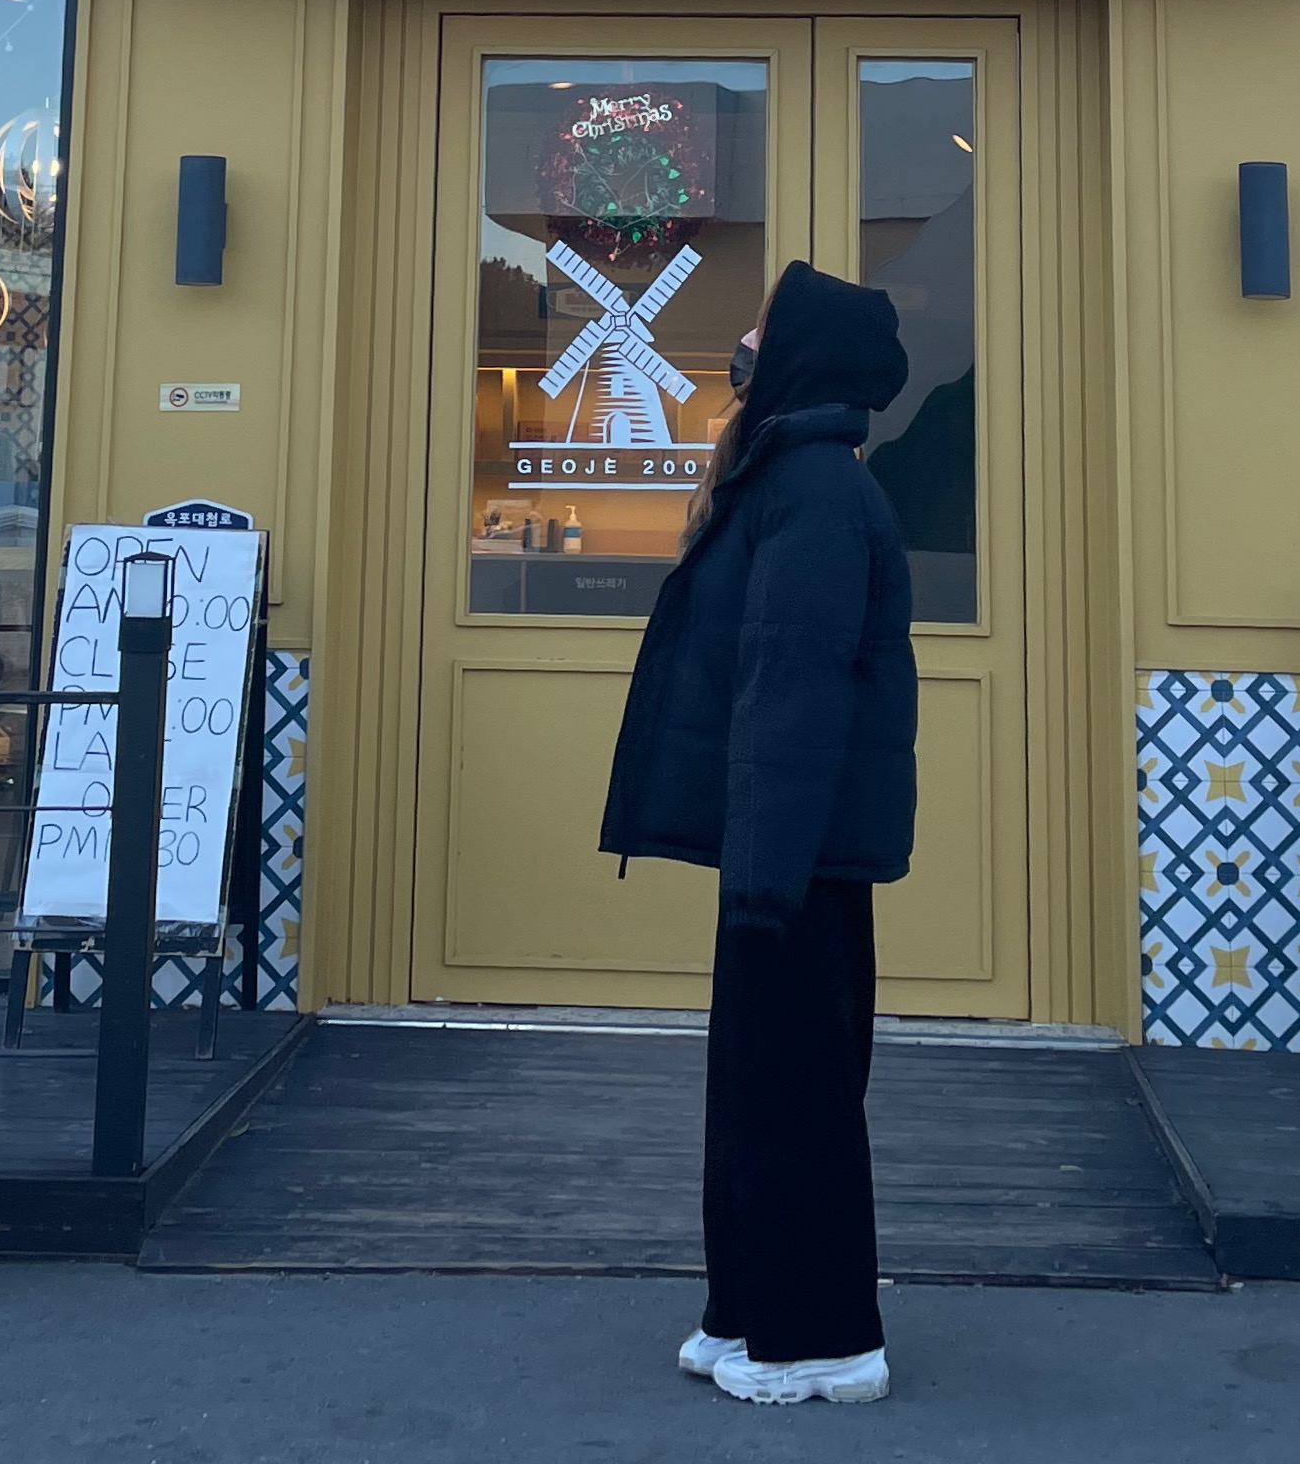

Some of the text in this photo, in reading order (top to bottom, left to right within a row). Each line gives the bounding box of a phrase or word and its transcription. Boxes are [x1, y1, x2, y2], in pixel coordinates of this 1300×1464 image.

[589, 93, 652, 122] Merry
[571, 103, 673, 140] Christmas
[516, 458, 711, 475] GEOJE 200
[163, 511, 233, 527] 옥포대첩로
[575, 577, 627, 590] 일반쓰레기
[81, 781, 208, 823] OER
